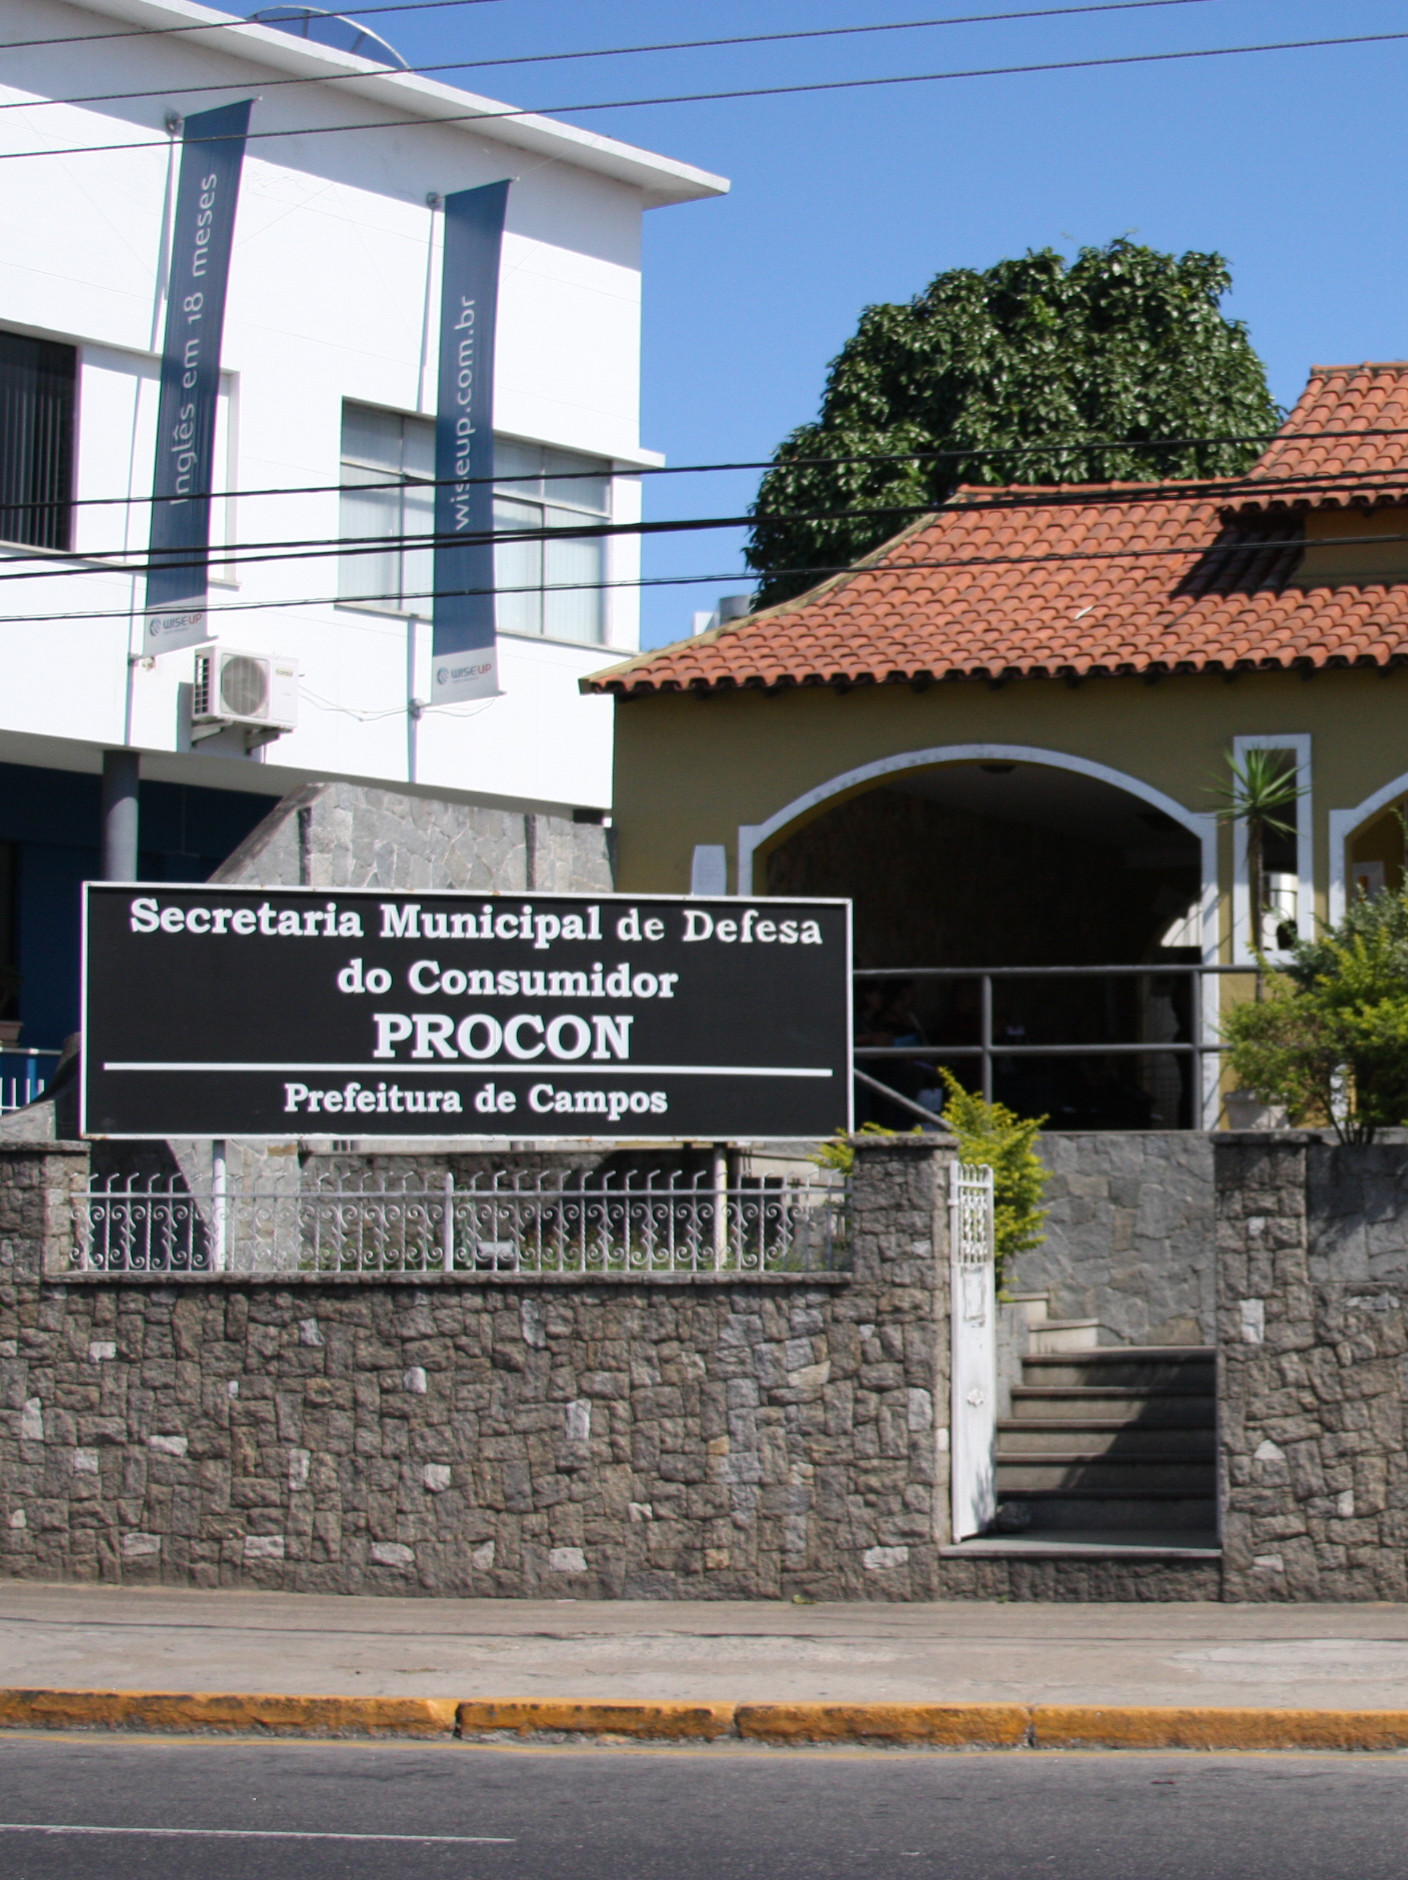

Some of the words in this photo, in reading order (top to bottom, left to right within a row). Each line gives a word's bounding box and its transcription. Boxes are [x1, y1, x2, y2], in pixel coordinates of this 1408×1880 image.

[192, 173, 217, 277] meses
[183, 292, 204, 325] 18
[183, 338, 200, 389] em
[450, 296, 476, 530] wiseup.com.br
[170, 403, 198, 505] Inglês
[130, 897, 364, 937] Secretaria
[379, 903, 603, 950] Municipal
[616, 908, 665, 941] de
[682, 909, 823, 944] Defesa
[337, 958, 393, 994] do
[408, 959, 679, 998] Consumidor
[372, 1012, 634, 1060] PROCON
[283, 1082, 463, 1113] Prefeitura
[475, 1083, 517, 1113] de
[527, 1083, 669, 1121] Campos
